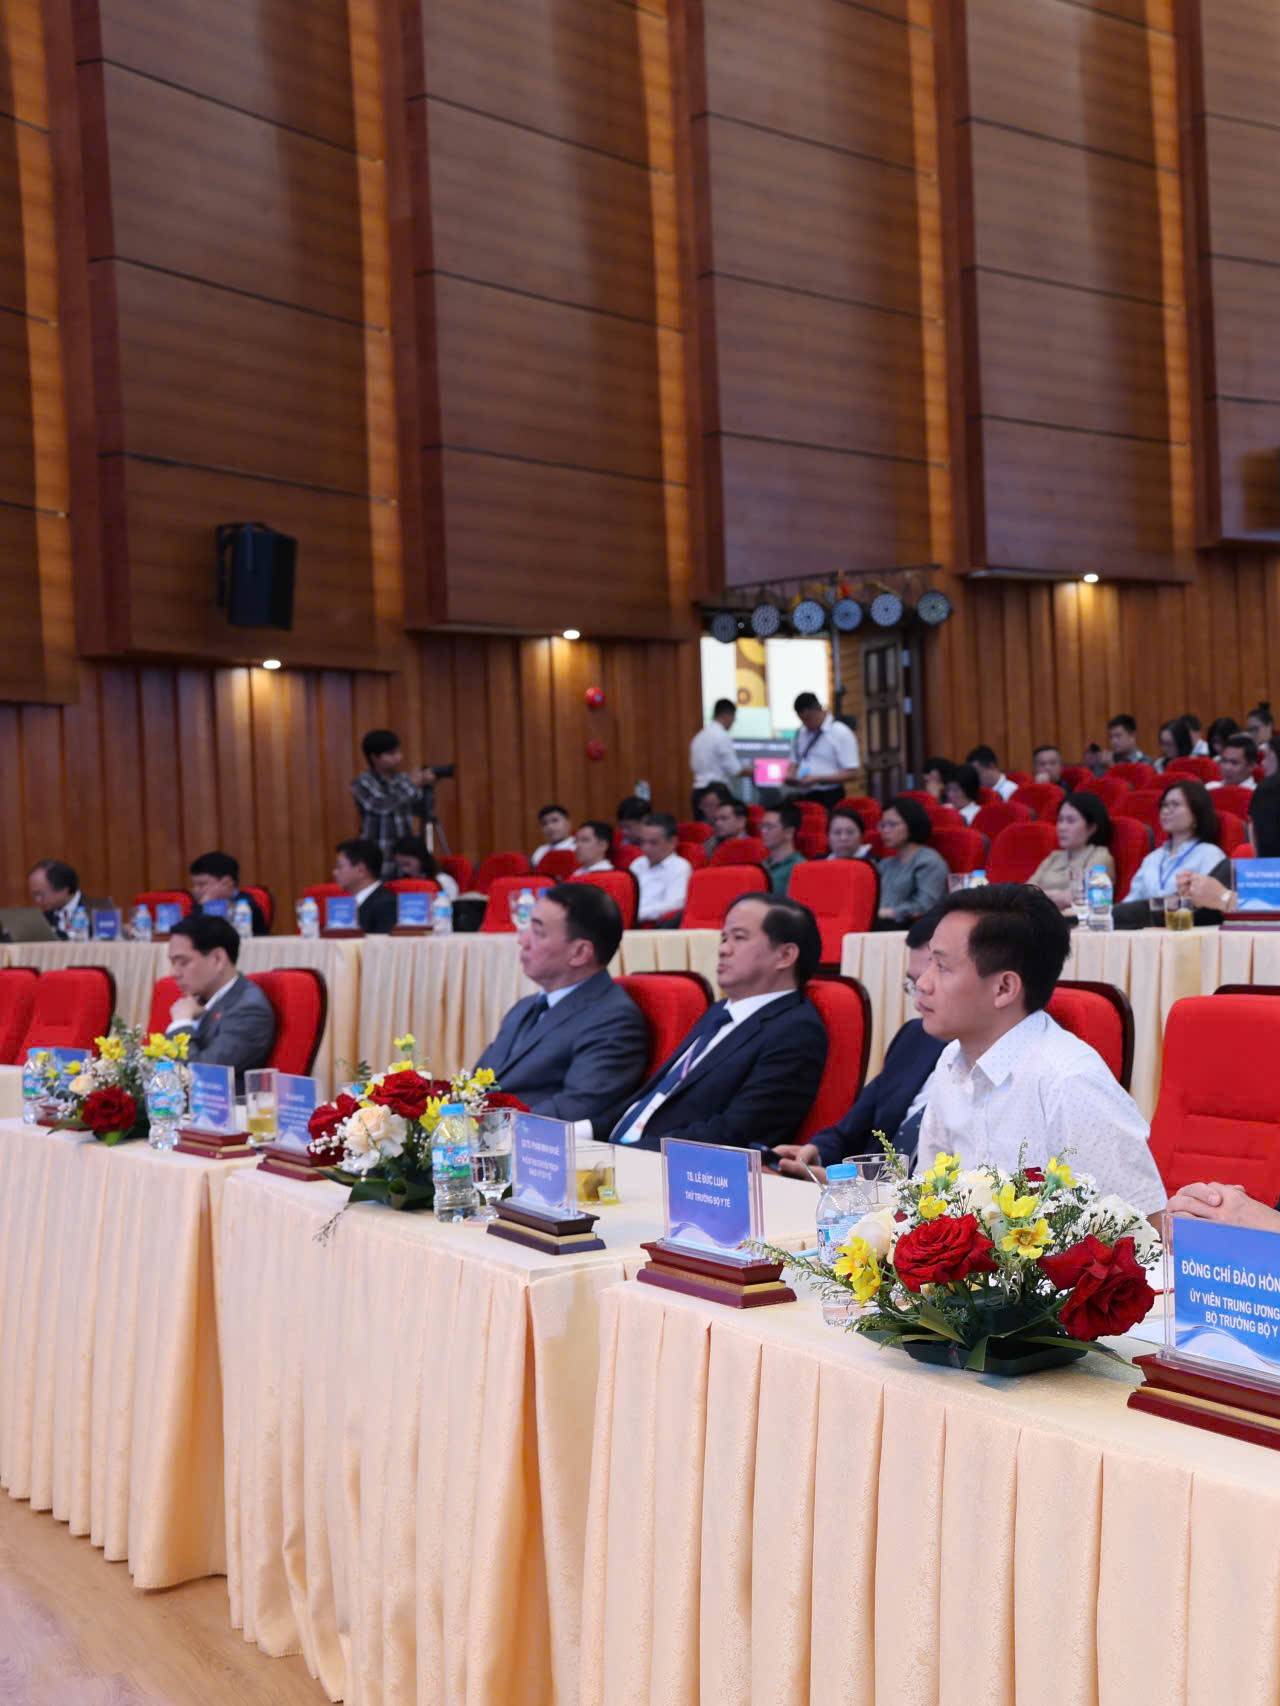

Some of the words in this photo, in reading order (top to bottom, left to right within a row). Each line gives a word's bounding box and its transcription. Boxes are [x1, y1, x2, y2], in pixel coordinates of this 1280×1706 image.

[1181, 1258, 1211, 1279] ĐỒNG
[1213, 1265, 1231, 1284] CHÍ
[1233, 1267, 1256, 1288] ĐÀO
[1201, 1291, 1221, 1308] VIÊN
[1222, 1297, 1252, 1314] TRUNG
[1253, 1303, 1280, 1321] ƯƠNG
[1205, 1311, 1218, 1327] BỘ
[1219, 1313, 1256, 1334] TRƯỞNG
[1258, 1322, 1271, 1339] BỘ
[1271, 1325, 1279, 1338] Y
